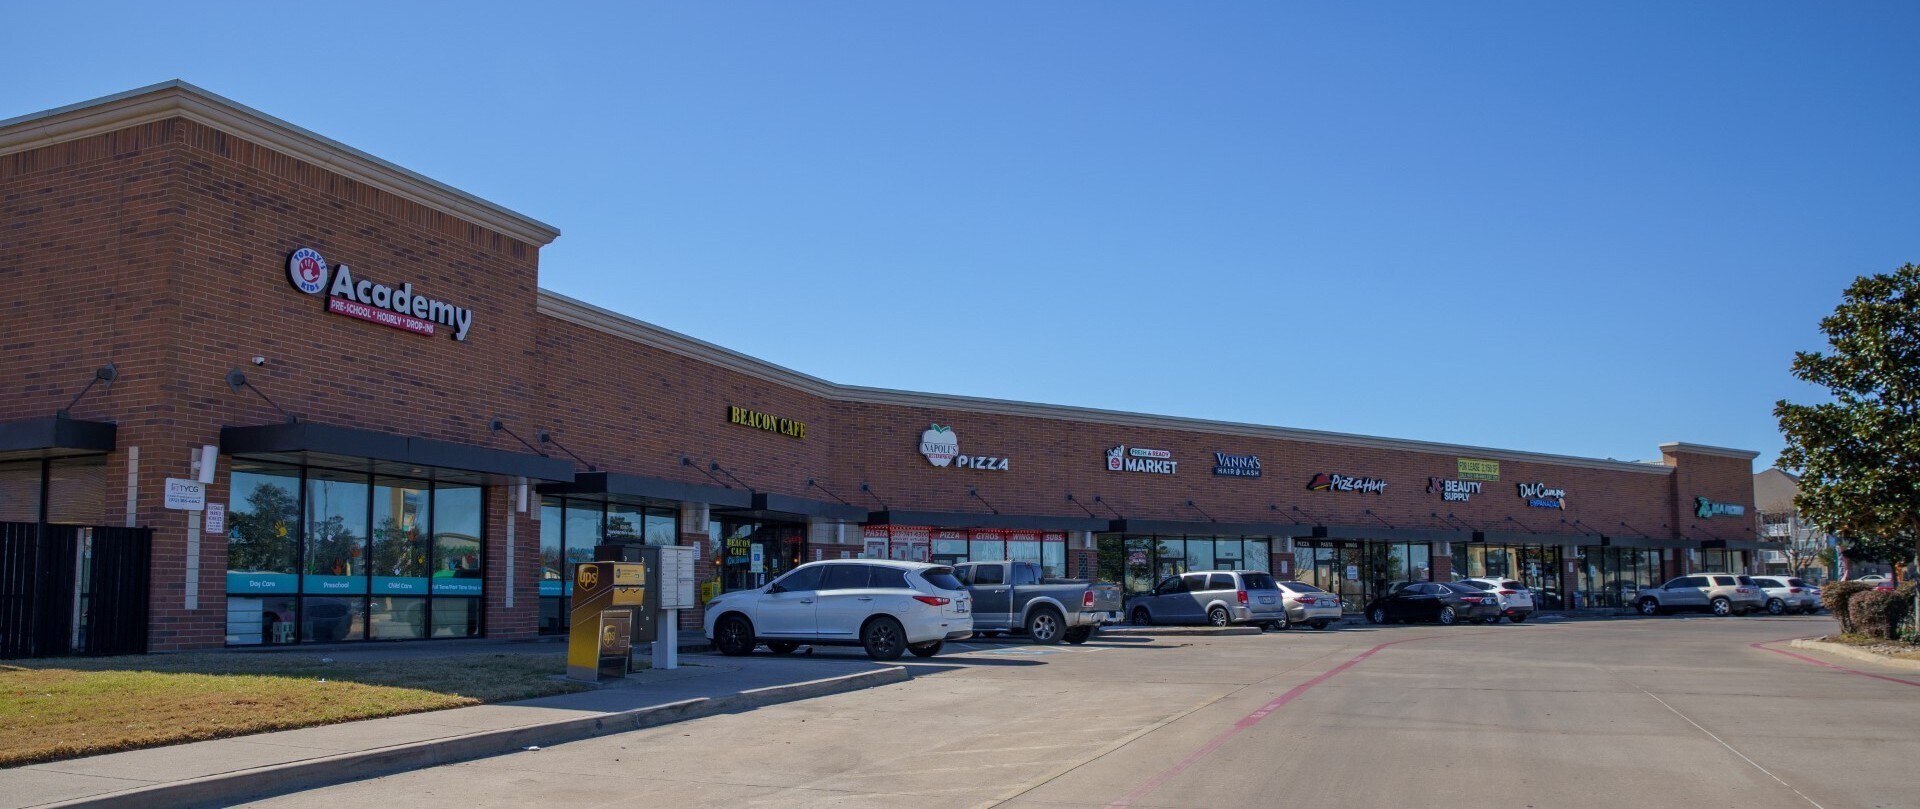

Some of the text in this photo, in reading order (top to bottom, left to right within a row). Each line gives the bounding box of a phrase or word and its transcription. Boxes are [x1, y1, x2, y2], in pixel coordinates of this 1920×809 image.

[294, 247, 325, 270] TODAY'S
[301, 282, 319, 292] KIDS
[330, 264, 472, 341] Academy
[331, 299, 434, 334] PRE-SCHOOL HOURLY DROP-INS
[731, 406, 806, 440] BEACON CAFE
[923, 443, 957, 455] NAPOLI'S
[957, 455, 1009, 471] PIZZA
[1125, 458, 1178, 474] MARKET
[1216, 452, 1261, 469] VANNA'S
[1467, 462, 1480, 472] LEASE
[180, 484, 199, 493] TYCG
[1330, 474, 1388, 495] Pizza Hut
[1445, 480, 1482, 494] BEAUTY
[1519, 482, 1566, 498] Del Campo
[1444, 493, 1470, 502] SUPPLY
[865, 529, 888, 537] PASTA
[940, 531, 960, 540] PIZZA
[976, 532, 999, 541] GYROS
[1012, 533, 1035, 541] WINGS
[727, 538, 751, 548] BEACON
[731, 547, 747, 556] CAFE
[250, 580, 276, 588] Day Care
[323, 581, 349, 589] Preschool
[580, 572, 597, 587] ups
